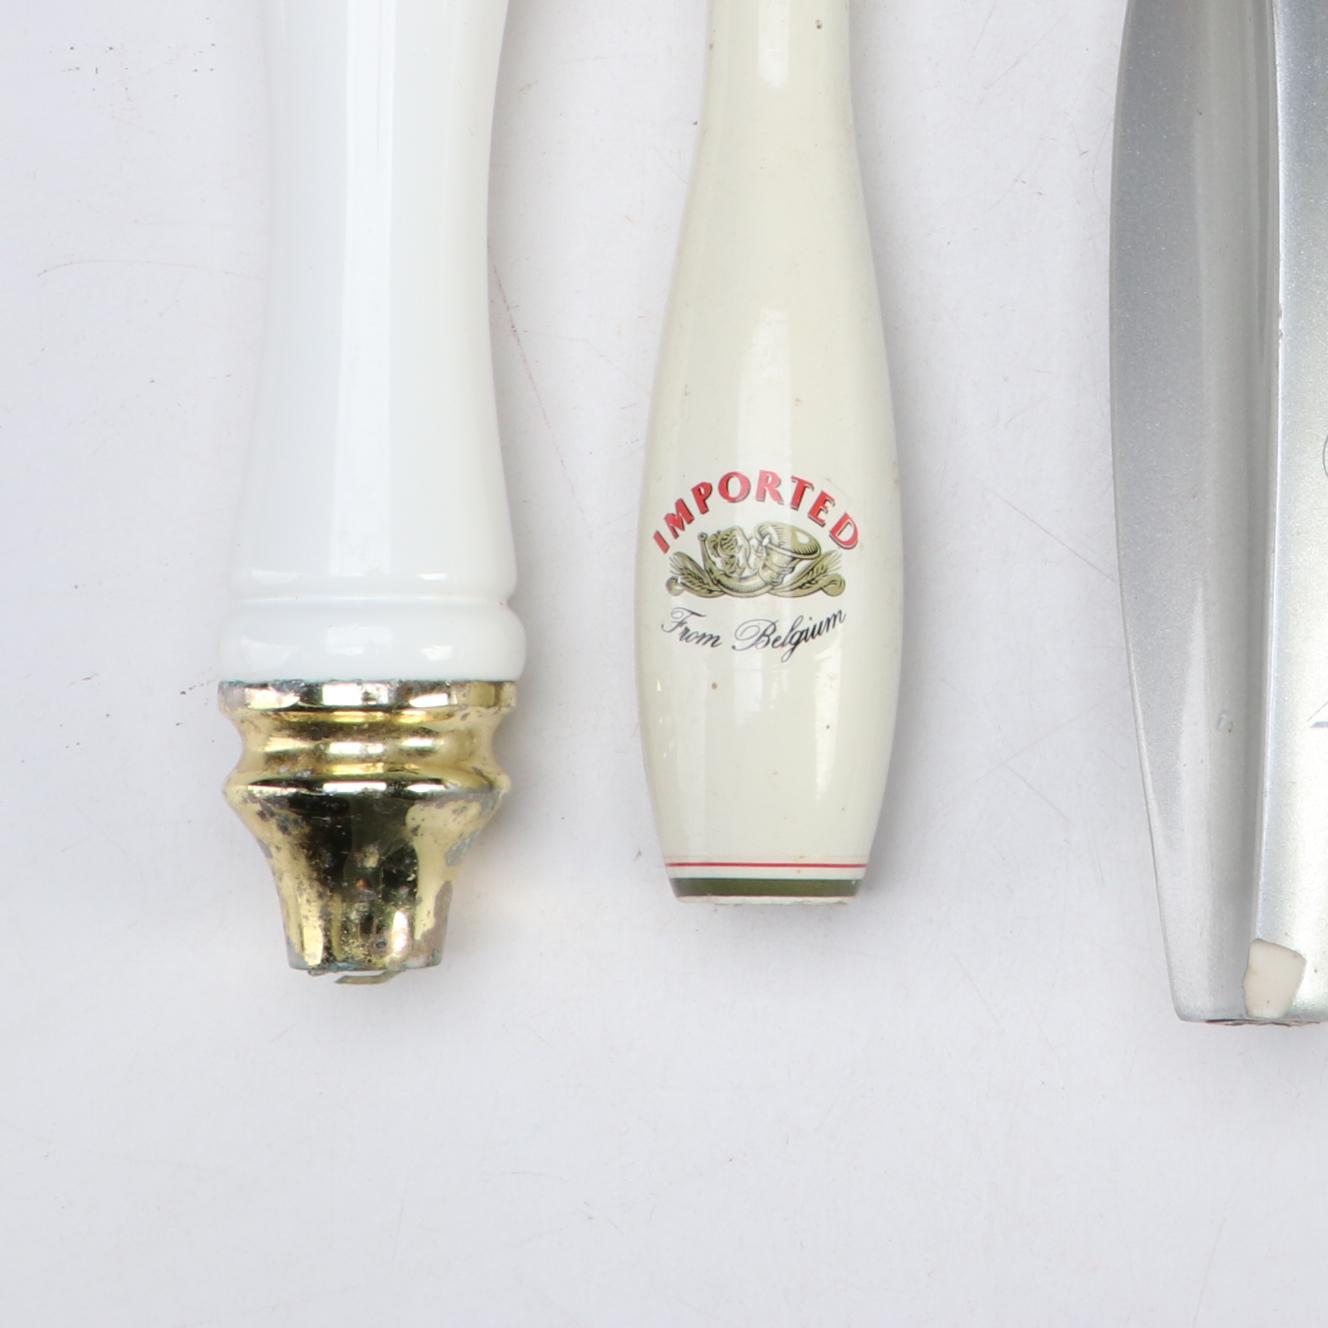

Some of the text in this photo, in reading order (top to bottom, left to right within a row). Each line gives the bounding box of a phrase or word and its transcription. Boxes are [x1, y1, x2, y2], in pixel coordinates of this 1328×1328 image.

[652, 470, 859, 554] IMPORTED
[661, 606, 847, 663] From Belgium
